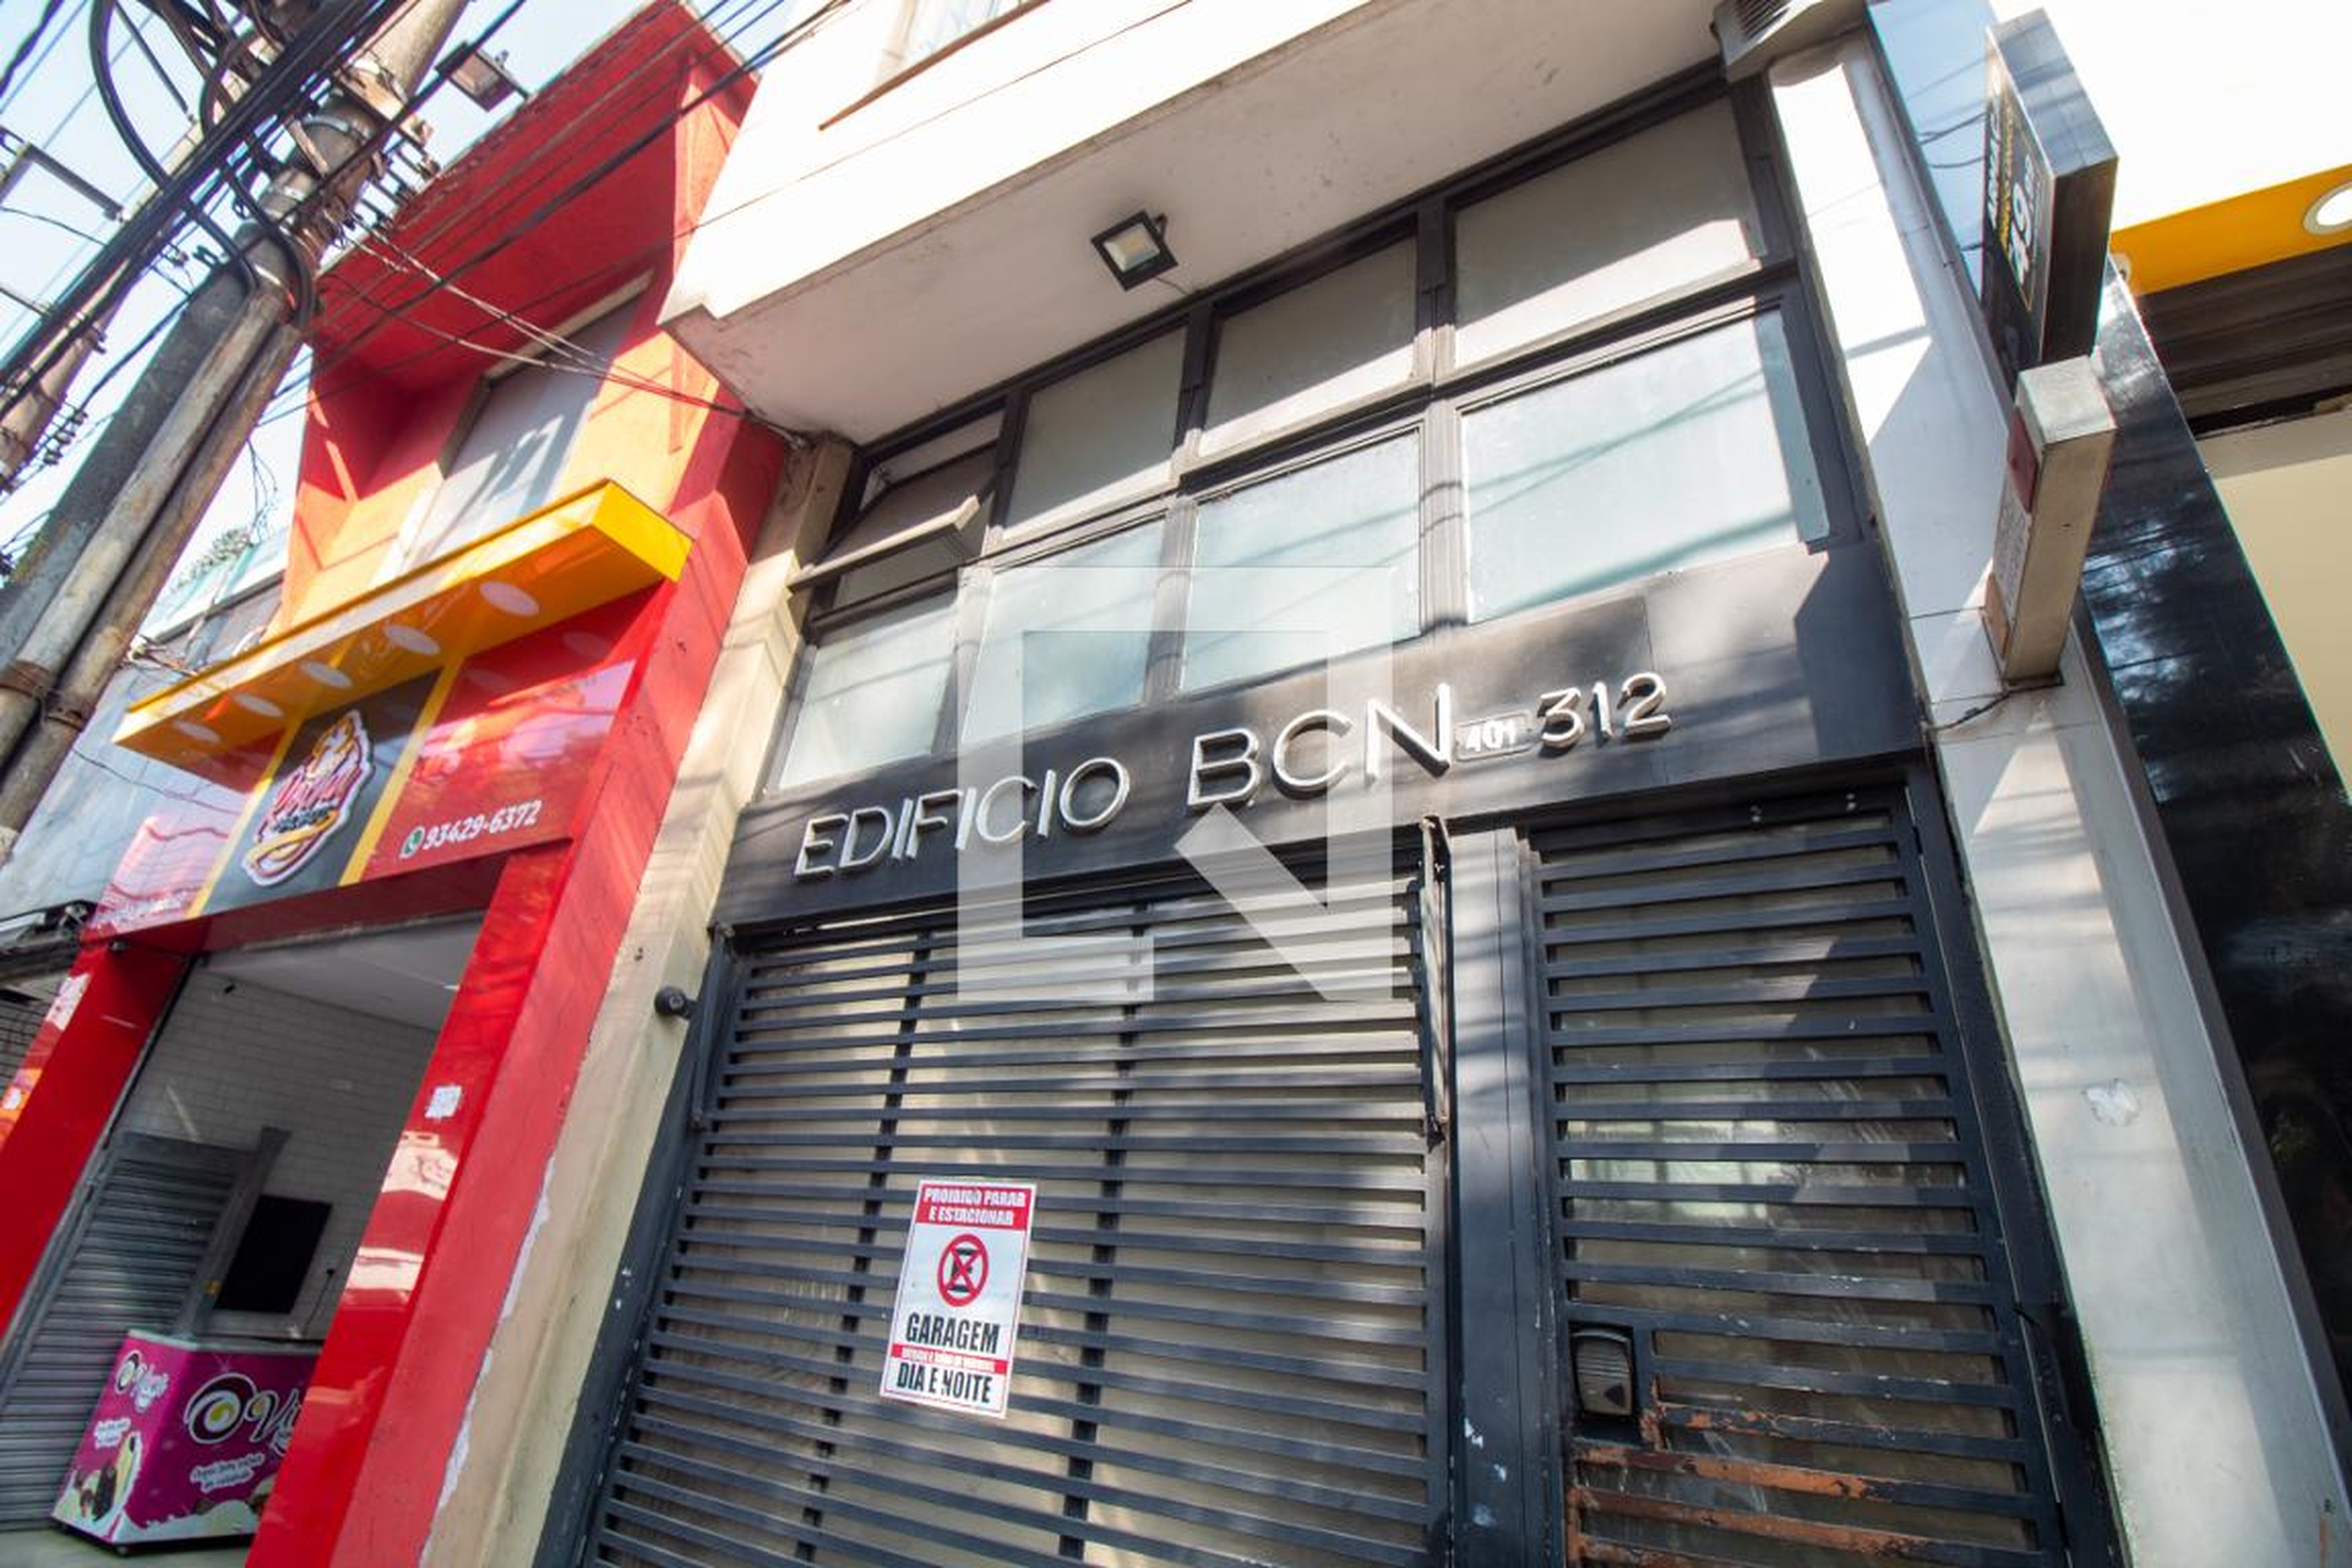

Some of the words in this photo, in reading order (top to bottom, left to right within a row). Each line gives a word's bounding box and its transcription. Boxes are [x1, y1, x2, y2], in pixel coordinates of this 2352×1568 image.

[794, 757, 1130, 876] EDIFICIO
[1187, 682, 1452, 807] BCN
[1538, 671, 1672, 750] 312
[923, 1188, 982, 1205] PROIBIDO
[984, 1191, 1027, 1207] PARAR
[929, 1205, 938, 1221] E
[938, 1207, 1014, 1225] ESTACIONAR
[906, 1312, 1000, 1354] GARAGEM
[897, 1362, 925, 1392] DIA
[929, 1367, 938, 1393] E
[941, 1370, 992, 1403] NOITE
